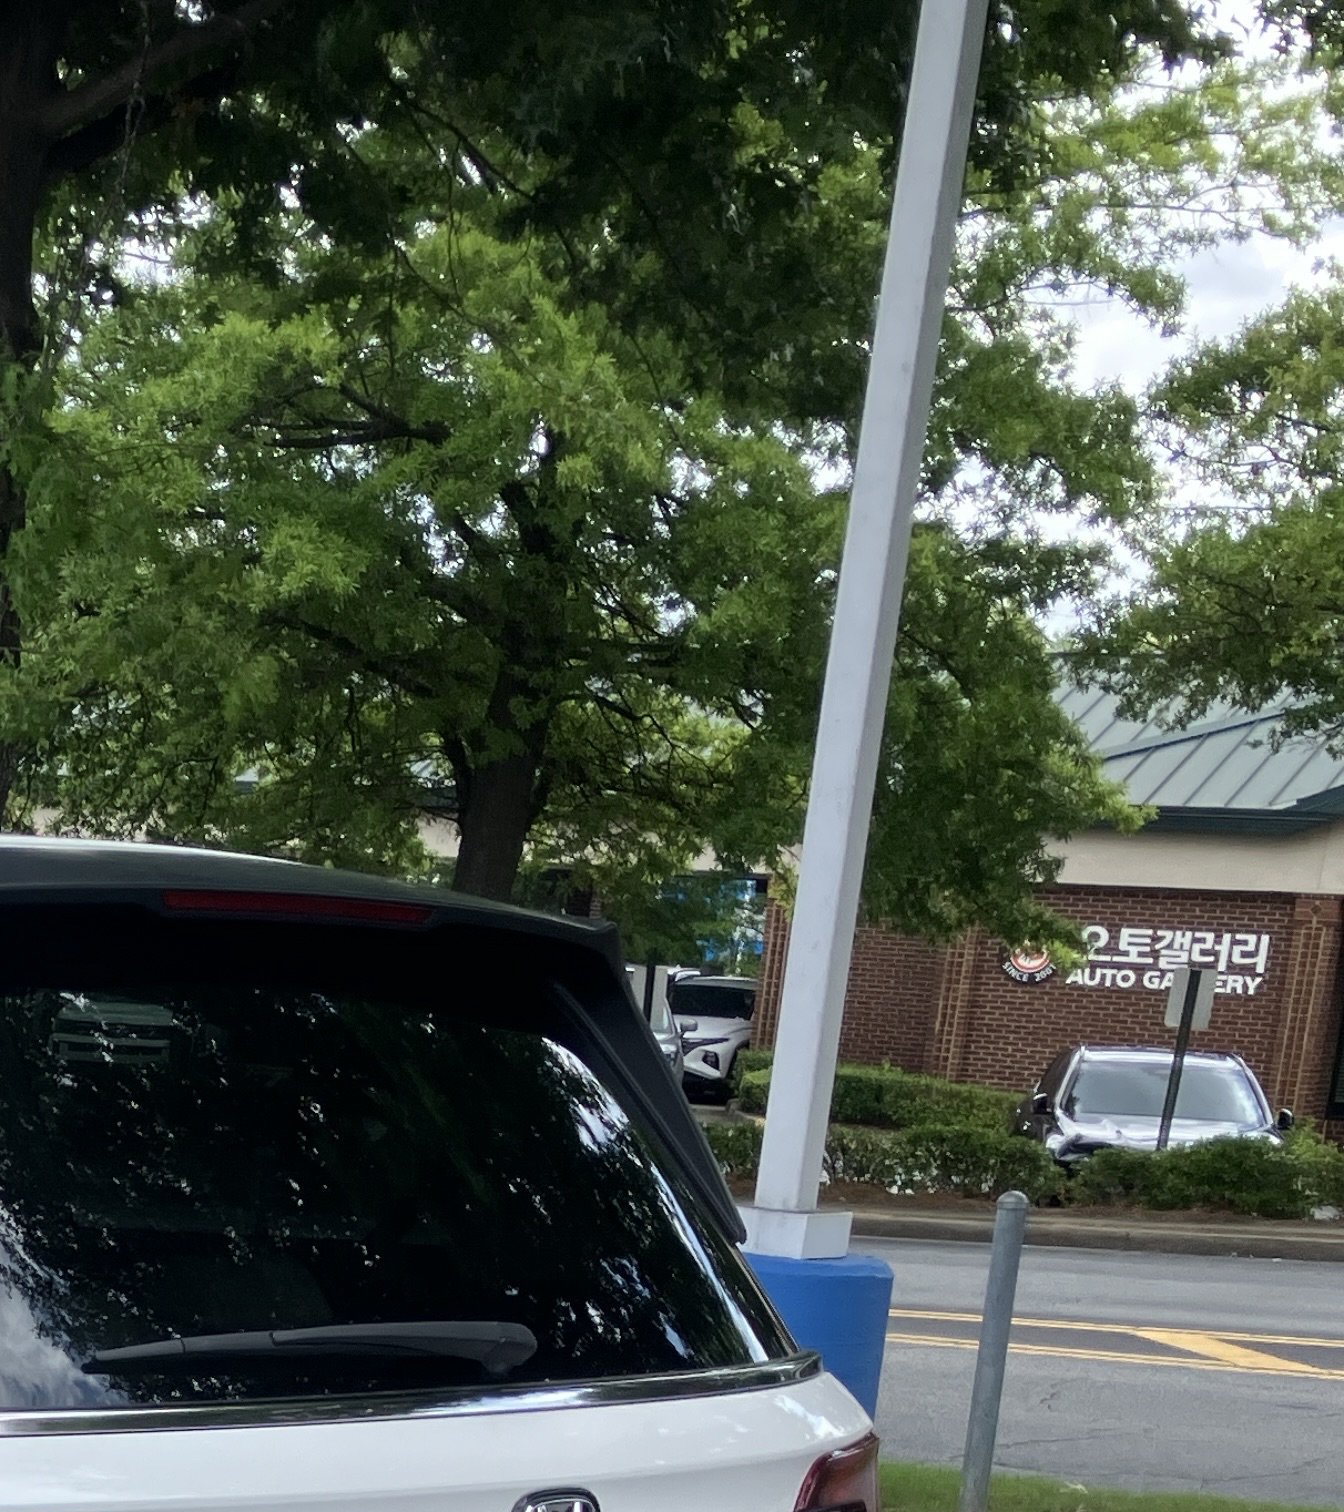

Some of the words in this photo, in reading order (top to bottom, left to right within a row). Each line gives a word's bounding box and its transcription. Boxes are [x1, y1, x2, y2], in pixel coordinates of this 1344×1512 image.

[1081, 925, 1270, 974] 오토갤러리
[1002, 961, 1029, 982] SINCE
[1065, 967, 1136, 988] AUTO
[1143, 970, 1262, 995] GAERY
